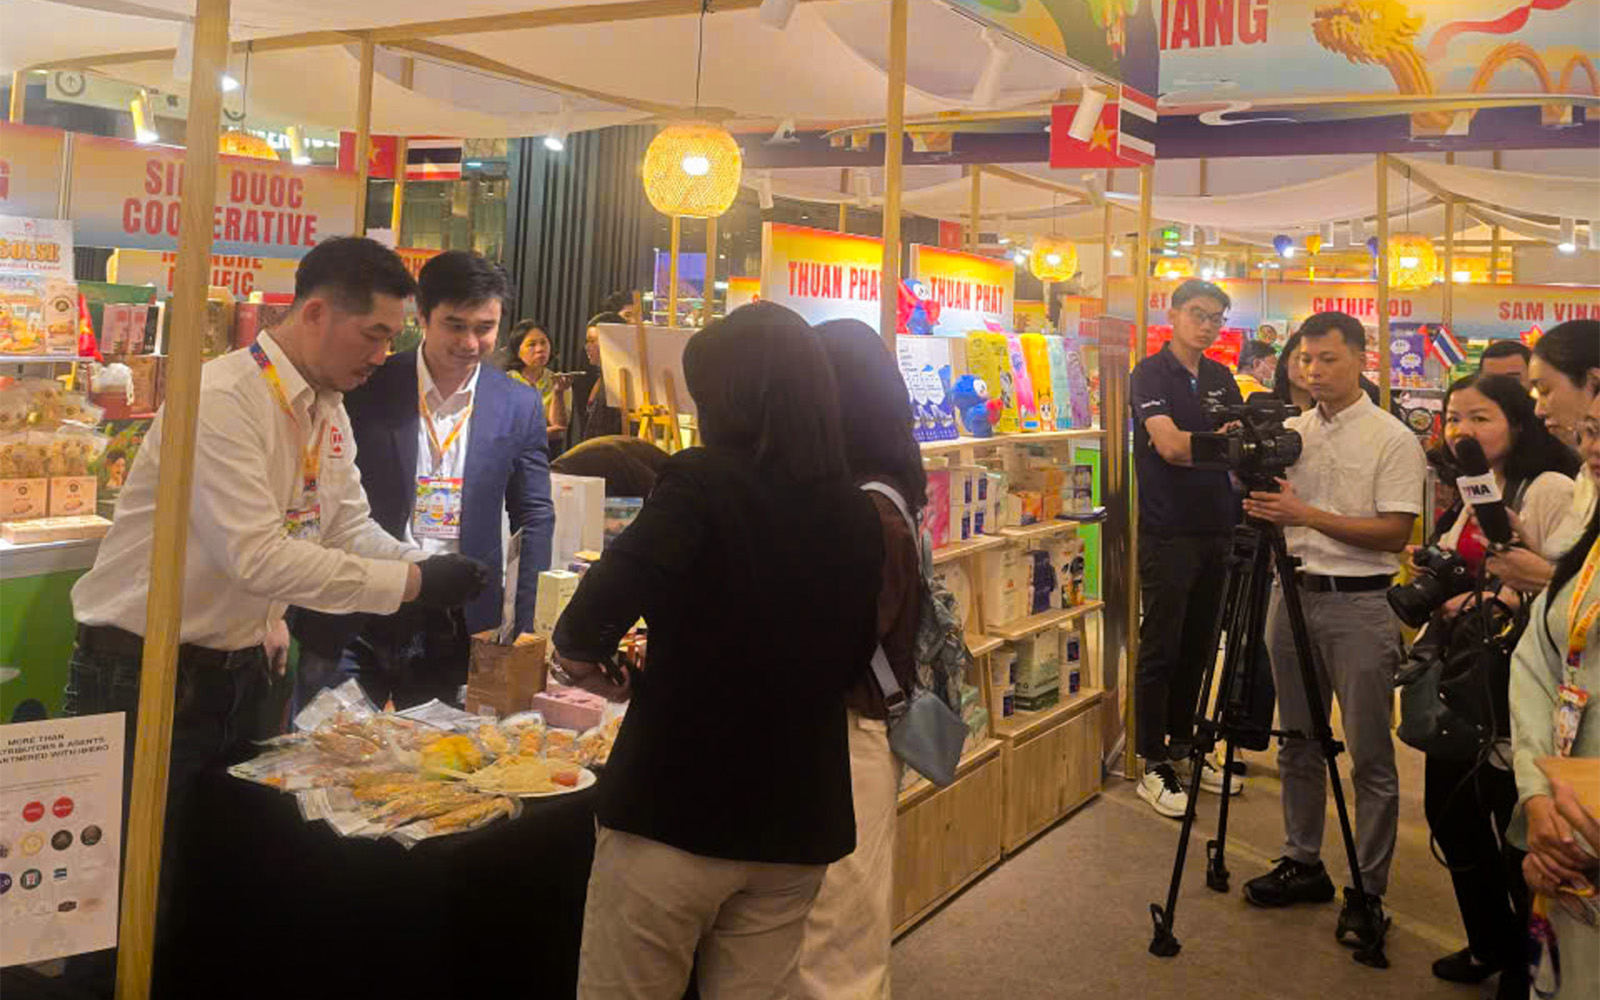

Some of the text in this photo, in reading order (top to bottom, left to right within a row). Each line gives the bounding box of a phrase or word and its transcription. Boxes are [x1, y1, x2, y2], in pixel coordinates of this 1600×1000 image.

[231, 170, 302, 209] DUOC
[122, 197, 318, 247] COOERATIVE
[788, 261, 842, 299] THUAN
[930, 276, 1005, 315] THUAN PHAT
[1312, 297, 1412, 318] CATHIFOD
[1499, 301, 1544, 321] SAM
[39, 734, 64, 743] THAN
